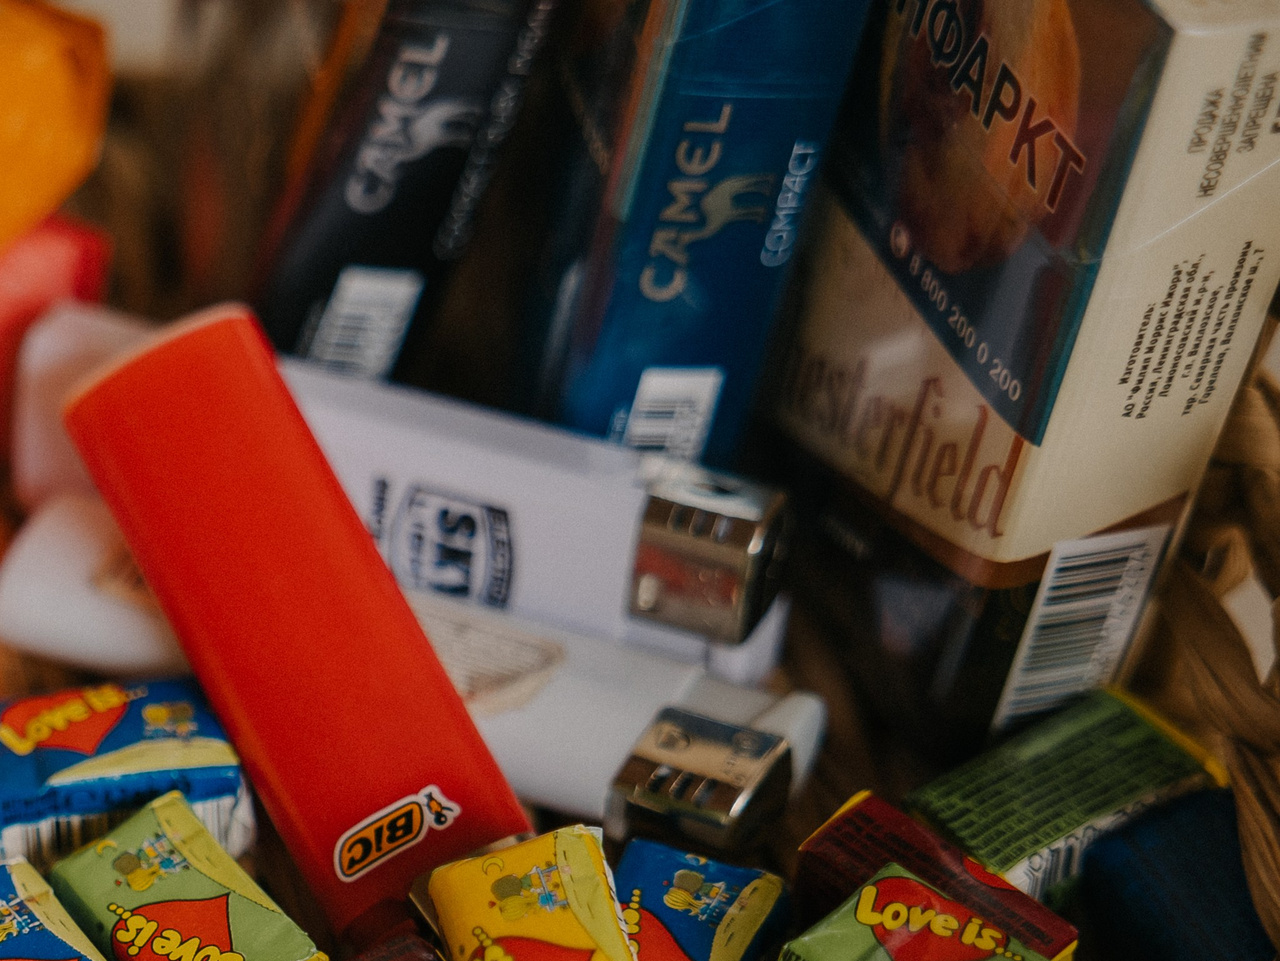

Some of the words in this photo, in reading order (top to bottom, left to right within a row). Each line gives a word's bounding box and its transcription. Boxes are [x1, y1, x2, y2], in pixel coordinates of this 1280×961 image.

[344, 33, 451, 213] CAMEL
[638, 103, 733, 301] CAMEL
[920, 269, 948, 312] 800
[947, 304, 976, 349] 200
[976, 341, 989, 366] 0
[988, 358, 1022, 402] 200
[1120, 402, 1136, 418] АО
[1142, 310, 1170, 354] Моррис
[346, 812, 417, 871] BIC
[106, 902, 160, 957] is...
[854, 884, 960, 937] Love
